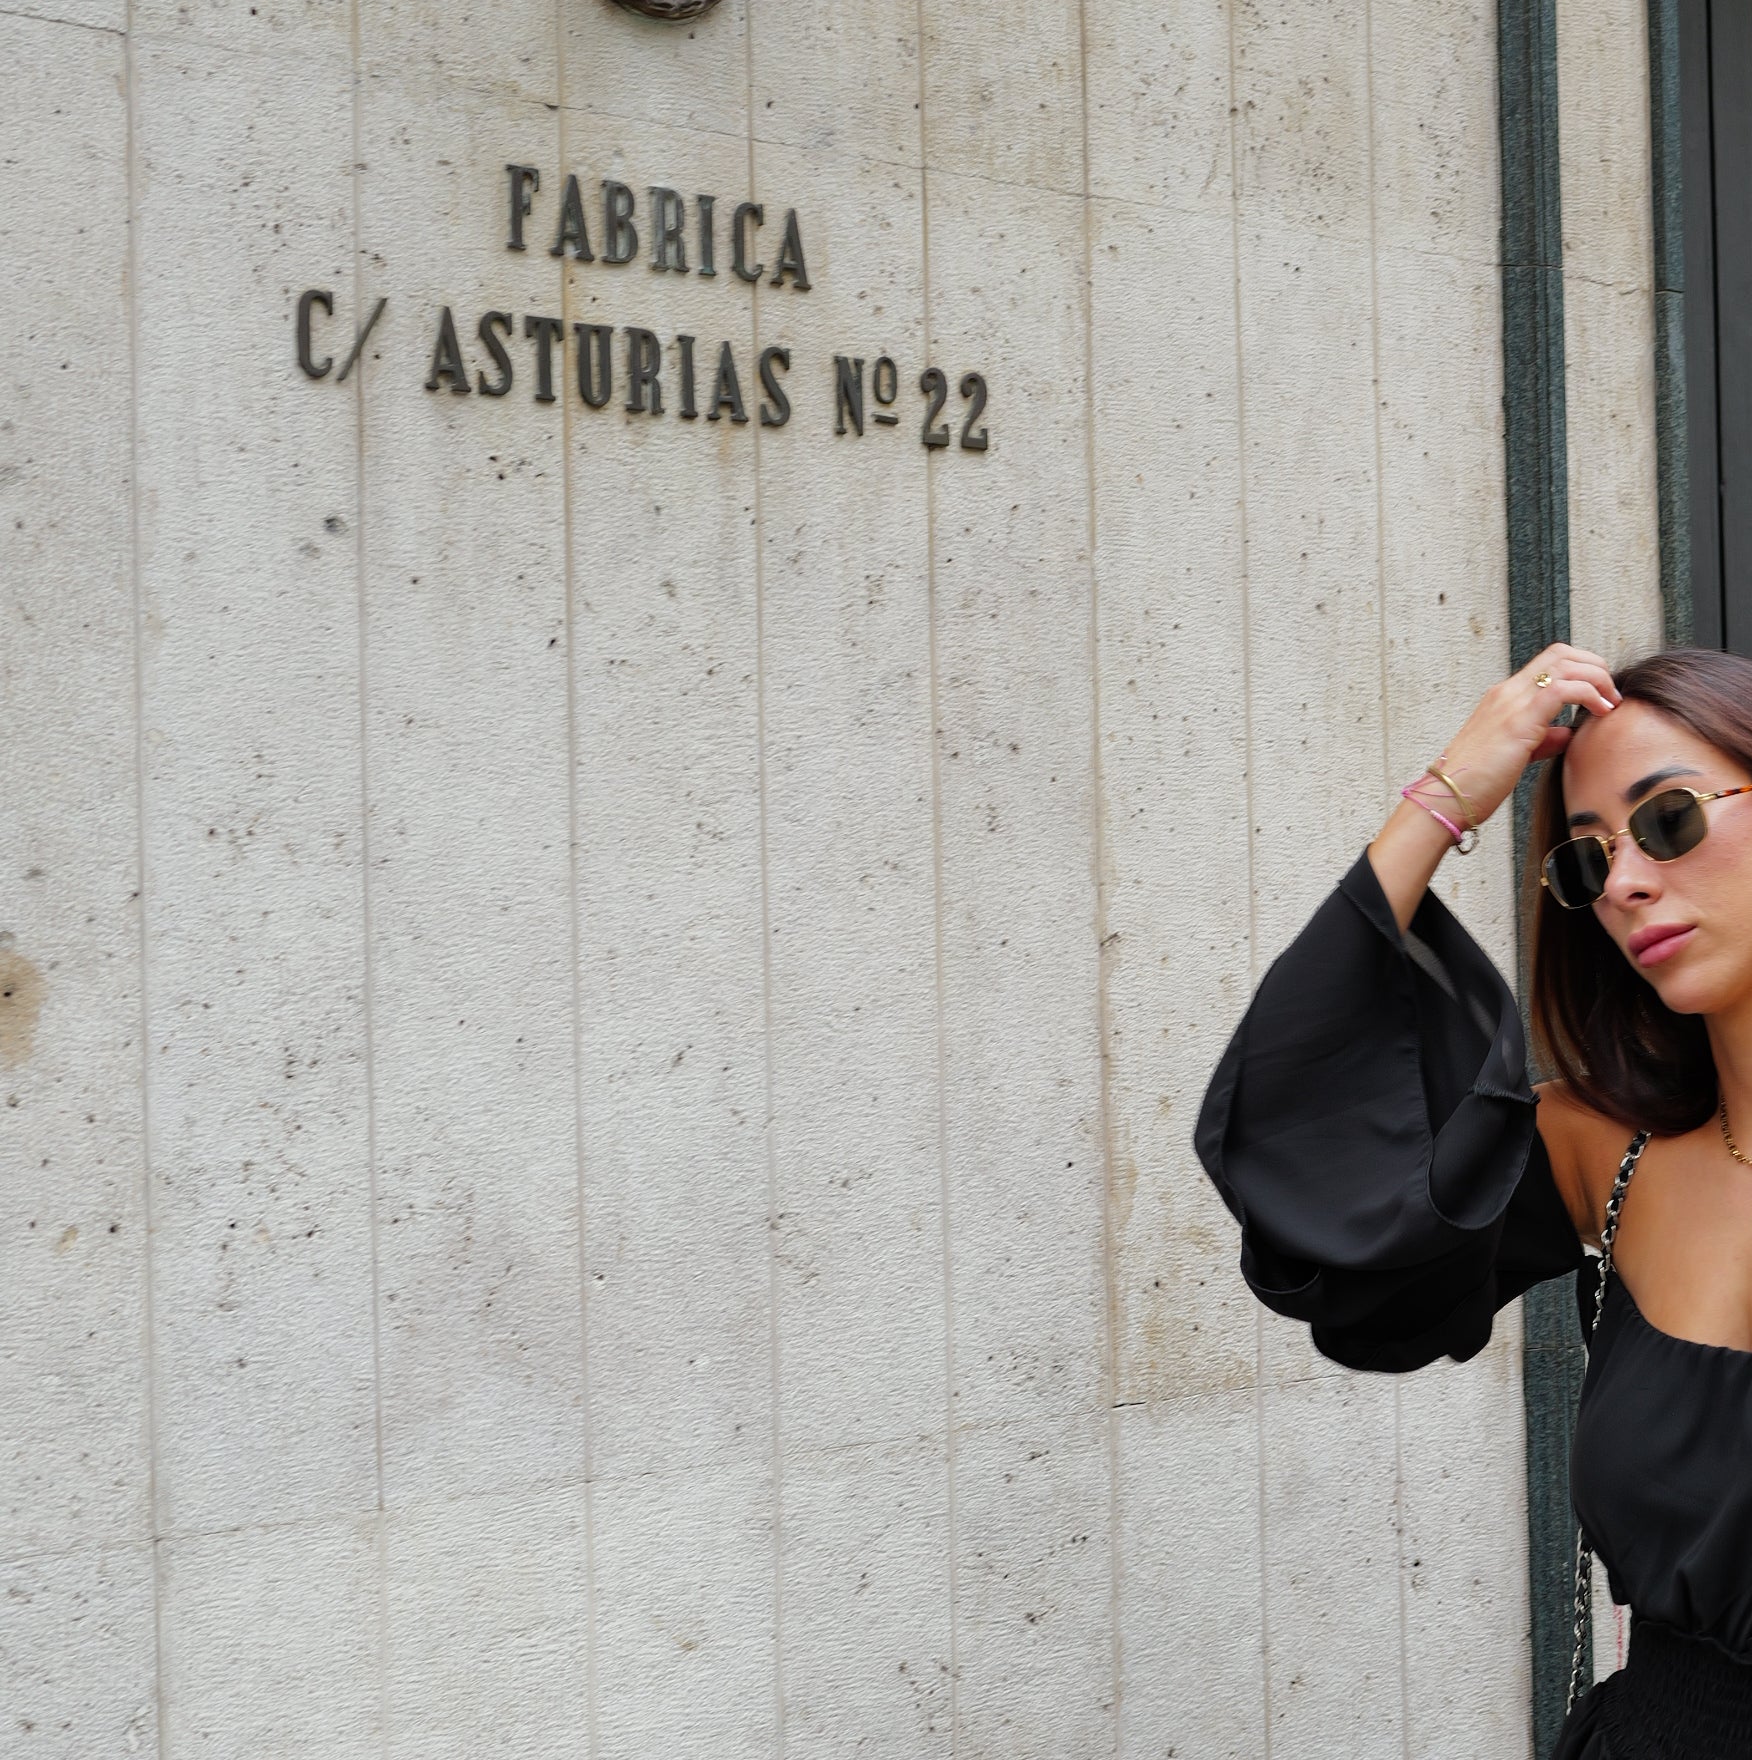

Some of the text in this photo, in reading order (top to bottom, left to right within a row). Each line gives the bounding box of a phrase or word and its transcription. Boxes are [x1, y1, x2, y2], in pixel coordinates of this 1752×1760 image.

[505, 163, 812, 292] FABRICA
[299, 289, 387, 381] C/
[424, 306, 791, 428] ASTURIAS
